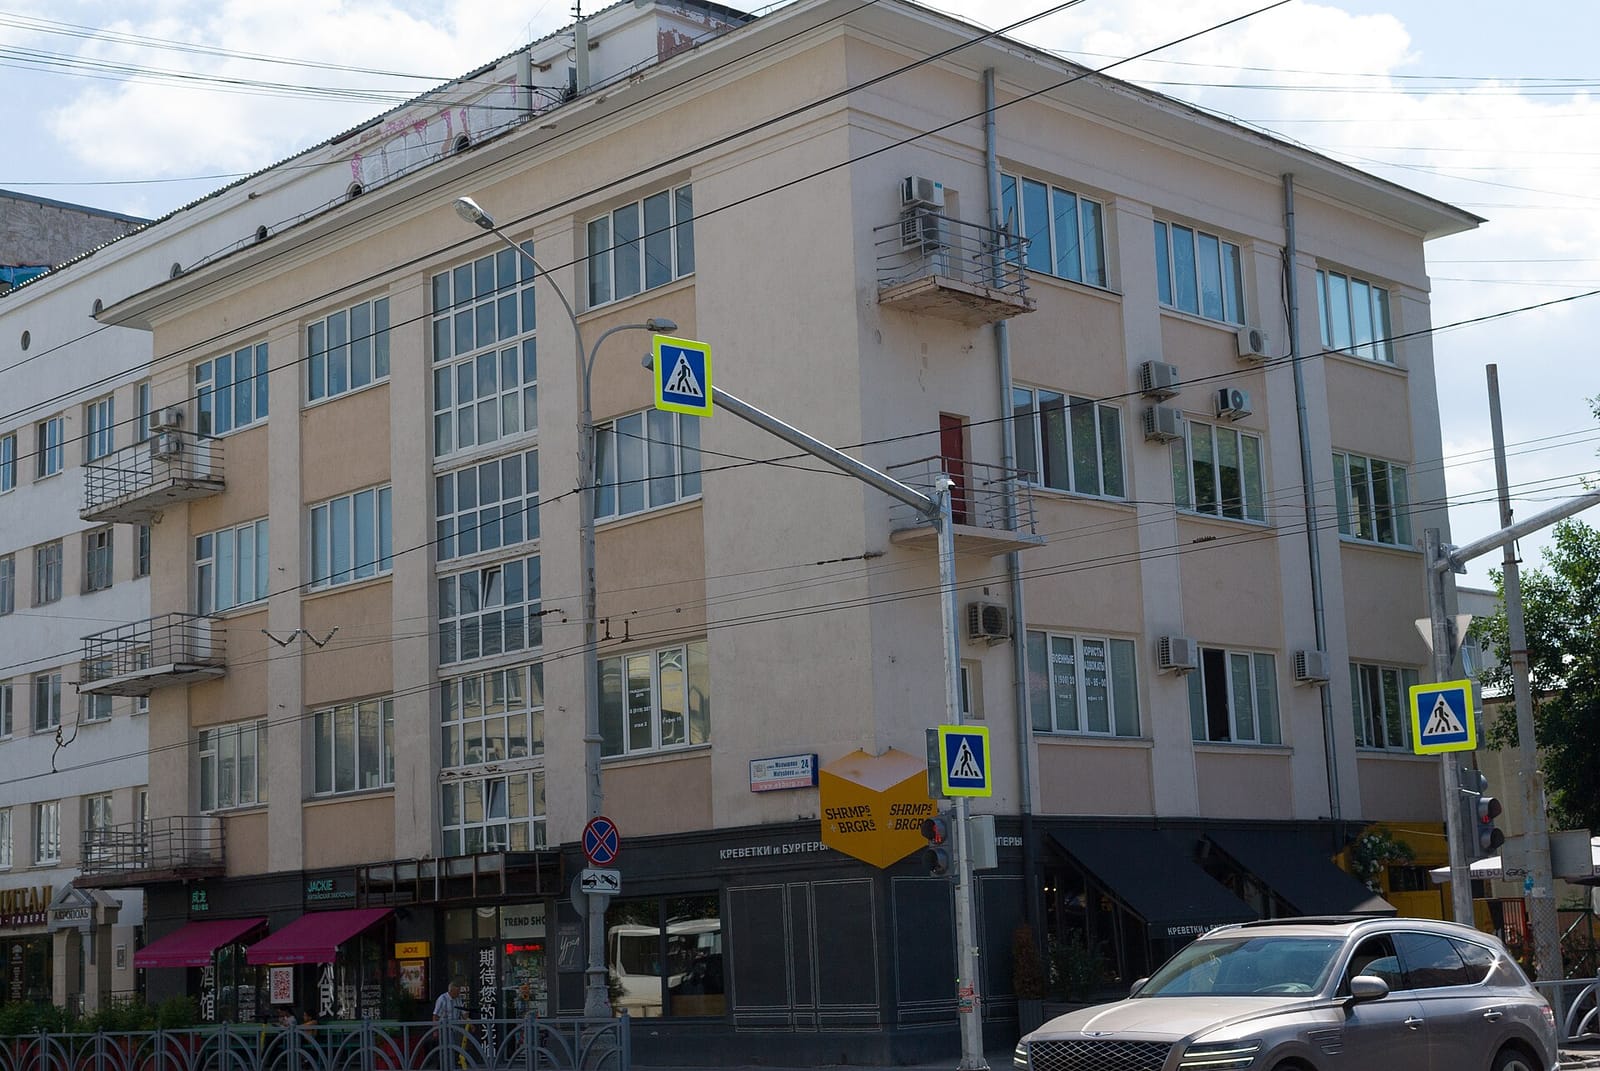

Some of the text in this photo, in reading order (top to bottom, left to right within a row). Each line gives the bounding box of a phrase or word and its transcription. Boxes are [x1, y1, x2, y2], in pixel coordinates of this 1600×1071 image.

[801, 759, 809, 769] 24
[719, 845, 770, 860] КРЕВЕТКИ
[307, 879, 334, 893] JACKIE
[504, 917, 530, 927] TREND
[1167, 925, 1204, 936] КРЕВЕТКИ
